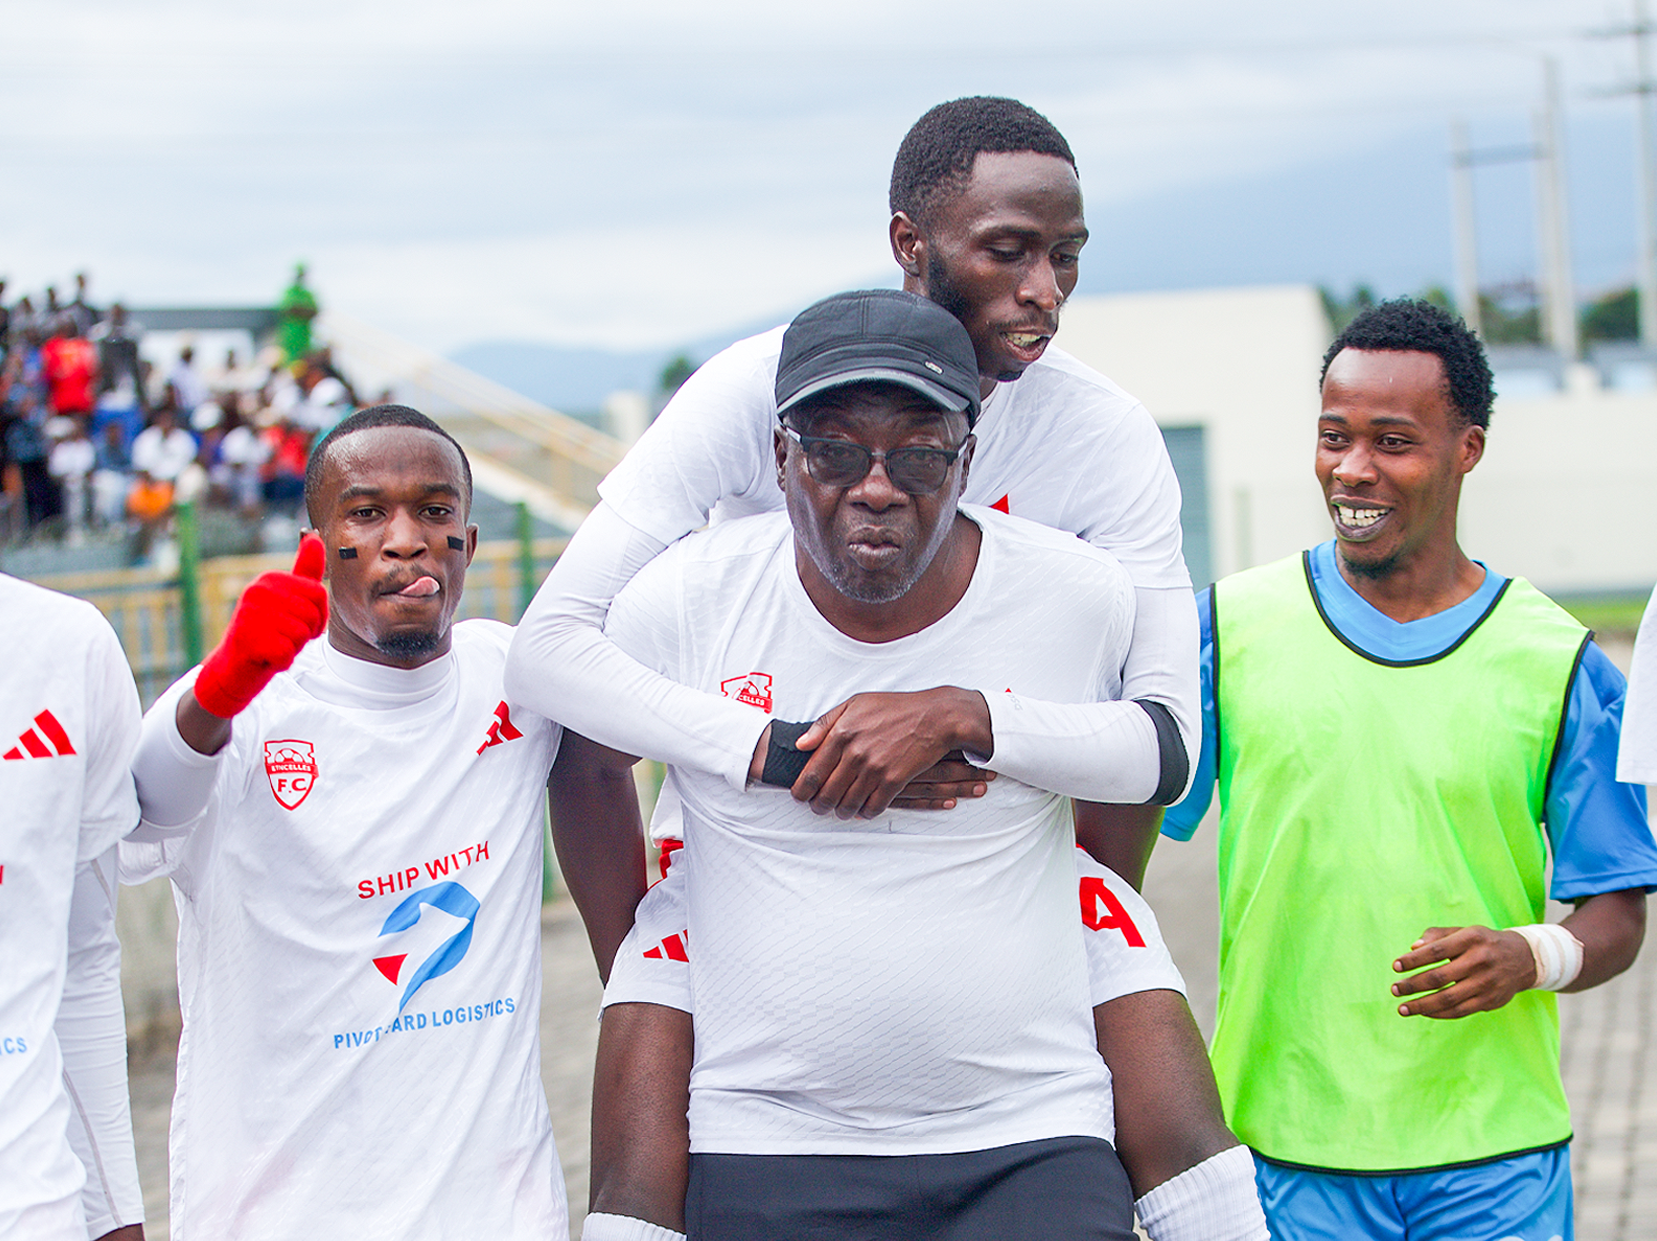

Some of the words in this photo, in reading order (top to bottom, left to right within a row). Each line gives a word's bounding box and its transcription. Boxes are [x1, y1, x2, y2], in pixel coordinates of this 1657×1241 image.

[357, 866, 420, 900] SHIP
[424, 840, 490, 880] WITH
[334, 1026, 382, 1049] PIVOT
[385, 1013, 427, 1034] ARD
[432, 997, 515, 1027] LOGISTICS
